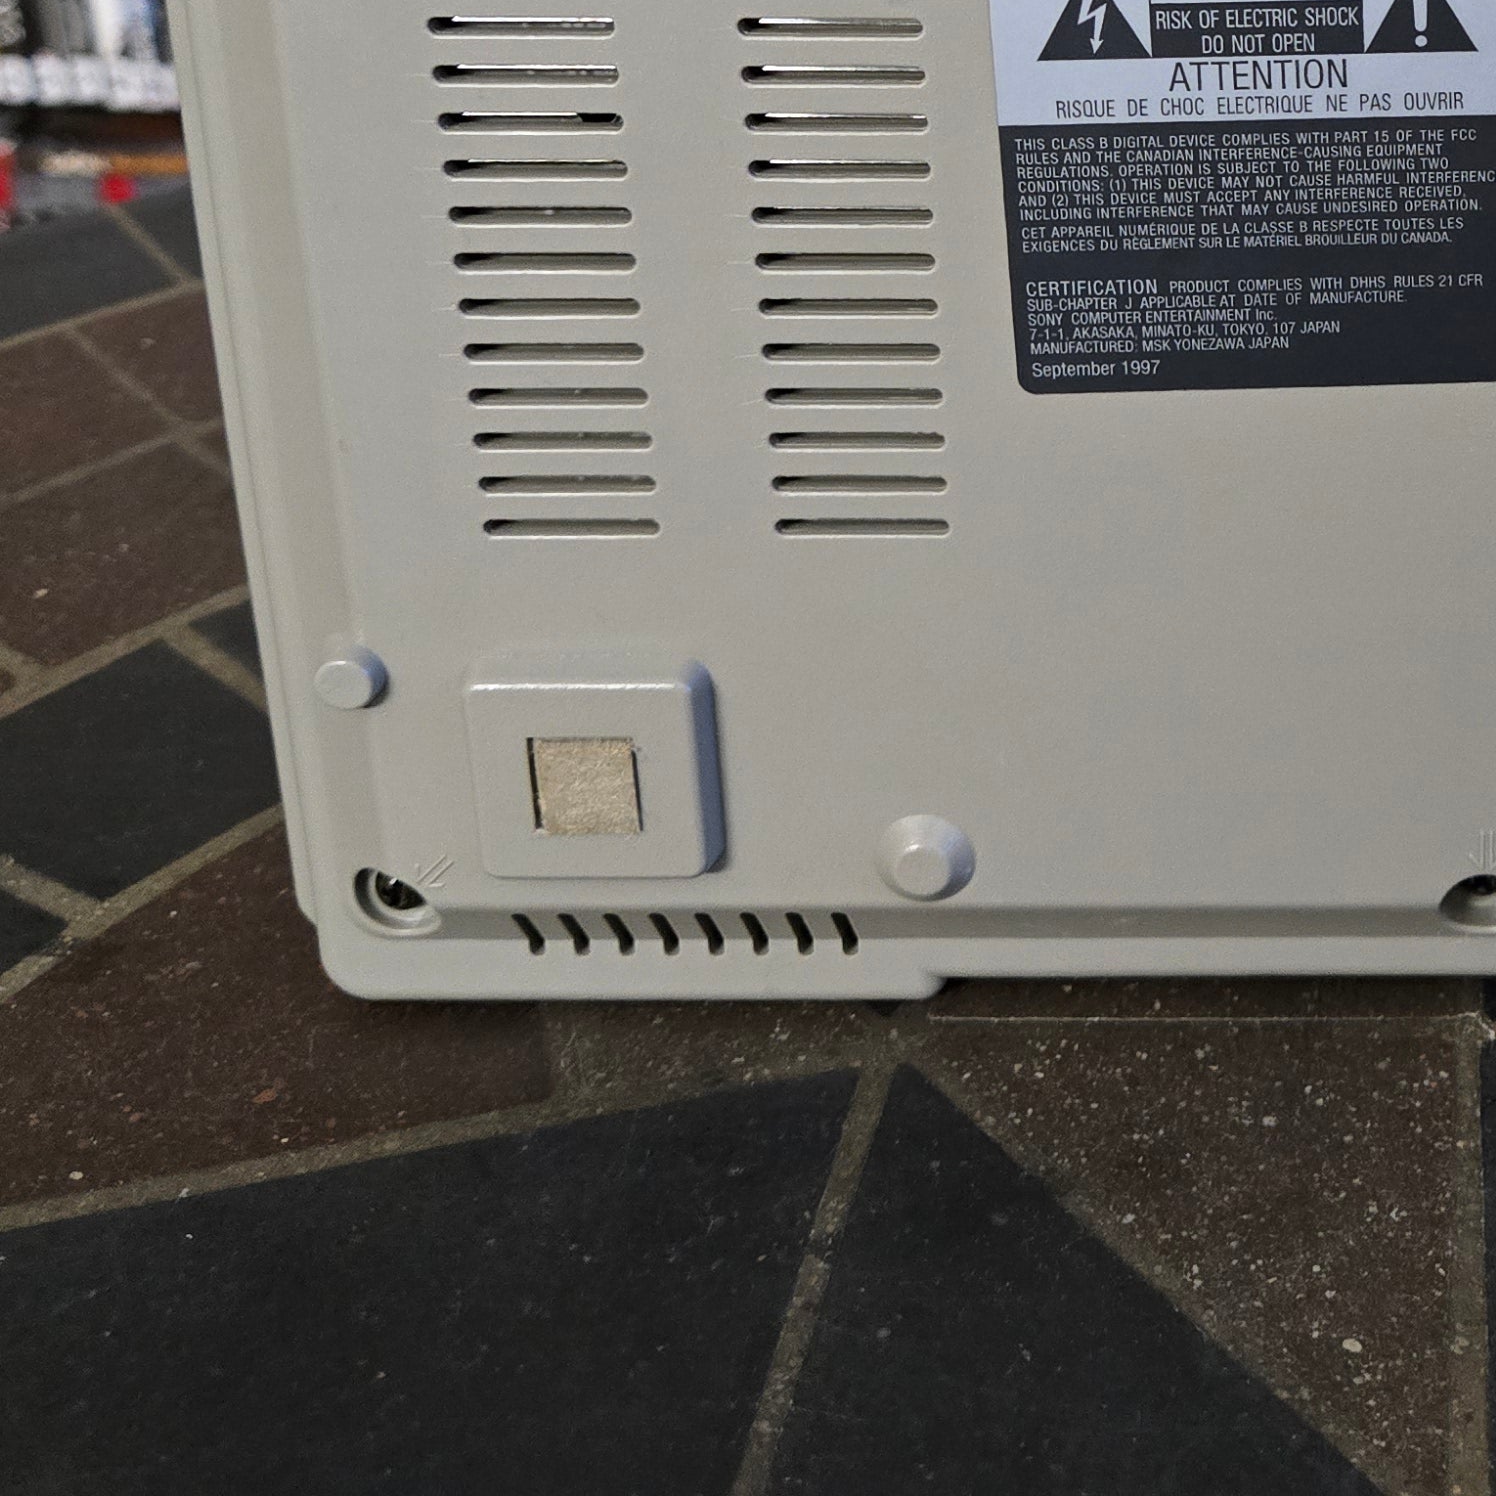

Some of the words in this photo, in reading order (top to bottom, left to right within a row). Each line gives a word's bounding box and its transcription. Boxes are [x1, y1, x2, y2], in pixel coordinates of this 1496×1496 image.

[1156, 10, 1192, 30] RISK
[1199, 9, 1219, 29] OF
[1226, 8, 1298, 28] ELECTRIC
[1305, 6, 1359, 26] SHOCK
[1202, 34, 1223, 54] DO
[1232, 33, 1265, 54] NOT
[1272, 32, 1314, 53] OPEN
[1169, 58, 1347, 92] ATTENTION
[1056, 99, 1115, 119] RISQUE
[1127, 98, 1148, 117] DE
[1161, 97, 1204, 117] CHOC
[1217, 94, 1312, 115] ELECTRIQUE
[1326, 94, 1347, 112] NE
[1360, 93, 1391, 112] PAS
[1404, 91, 1464, 111] OUVRIR
[1014, 138, 1045, 151] THIS
[1052, 136, 1094, 150] CLASS
[1100, 137, 1108, 149] B
[1114, 135, 1164, 149] DIGITAL
[1169, 134, 1215, 147] DEVICE
[1222, 132, 1290, 146] COMPLIES
[1296, 131, 1328, 145] WITH
[1335, 130, 1367, 143] PART
[1374, 130, 1389, 143] 15
[1396, 129, 1412, 142] OF
[1420, 129, 1444, 142] THE
[1451, 128, 1476, 141] FCC
[1016, 152, 1059, 166] RULES
[1064, 151, 1090, 165] AND
[1096, 150, 1121, 164] THE
[1126, 149, 1193, 163] CANADIAN
[1367, 143, 1442, 157] EQUIPMENT
[1119, 163, 1193, 177] OPERATION
[1199, 163, 1211, 175] IS
[1218, 160, 1276, 174] SUBJECT
[1283, 160, 1299, 173] TO
[1307, 159, 1331, 172] THE
[1338, 157, 1415, 172] FOLLOWING
[1420, 157, 1448, 170] TWO
[1110, 178, 1126, 192] (1)
[1131, 178, 1161, 191] THIS
[1168, 176, 1214, 190] DEVICE
[1222, 175, 1249, 188] MAY
[1256, 175, 1282, 188] NOT
[1290, 173, 1331, 187] CAUSE
[1337, 172, 1399, 186] HARMFUL
[1019, 194, 1046, 208] AND
[1052, 193, 1068, 207] (2)
[1074, 193, 1104, 206] THIS
[1111, 190, 1156, 206] DEVICE
[1164, 190, 1200, 204] MUST
[1207, 190, 1257, 203] ACCEPT
[1264, 189, 1290, 201] ANY
[1295, 186, 1392, 201] INTERFERENCE
[1020, 206, 1091, 221] INCLUDING
[1097, 204, 1194, 219] INTERFERENCE
[1200, 203, 1234, 217] THAT
[1242, 203, 1269, 216] MAY
[1276, 201, 1318, 215] CAUSE
[1324, 200, 1397, 214] UNDESIRED
[1405, 198, 1481, 212] OPERATION.
[1022, 226, 1046, 240] CET
[1051, 225, 1114, 238] APPAREIL
[1201, 222, 1218, 236] DE
[1223, 222, 1239, 234] LA
[1245, 221, 1294, 234] CLASSE
[1300, 221, 1308, 233] B
[1313, 218, 1378, 232] RESPECTE
[1384, 217, 1434, 231] TOUTES
[1440, 216, 1463, 230] LES
[1023, 239, 1095, 254] EXIGENCES
[1100, 239, 1118, 251] DU
[1199, 236, 1222, 249] SUR
[1226, 236, 1240, 248] LE
[1305, 232, 1377, 246] BROUILLEUR
[1381, 232, 1397, 245] DU
[1026, 279, 1157, 297] CERTIFICATION
[1170, 279, 1229, 293] PRODUCT
[1238, 278, 1302, 292] COMPLIES
[1310, 277, 1342, 290] WITH
[1350, 275, 1385, 289] DHHS
[1394, 275, 1434, 288] RULES
[1439, 274, 1452, 288] 21
[1459, 273, 1482, 286] CFR
[1027, 297, 1117, 312] SUB-CHAPTER
[1125, 296, 1132, 309] J
[1140, 294, 1216, 309] APPLICABLE
[1219, 294, 1235, 307] AT
[1244, 292, 1277, 307] DATE
[1286, 292, 1301, 305] OF
[1028, 312, 1063, 326] SONY
[1071, 311, 1141, 325] COMPUTER
[1146, 308, 1251, 324] ENTERTAINMENT
[1256, 309, 1277, 321] Inc.
[1273, 321, 1295, 335] 107
[1300, 320, 1340, 335] JAPAN
[1142, 338, 1171, 352] MSK
[1174, 335, 1245, 351] YONEZAWA
[1248, 336, 1289, 350] JAPAN
[1032, 361, 1116, 380] September
[1122, 359, 1160, 375] 1997
